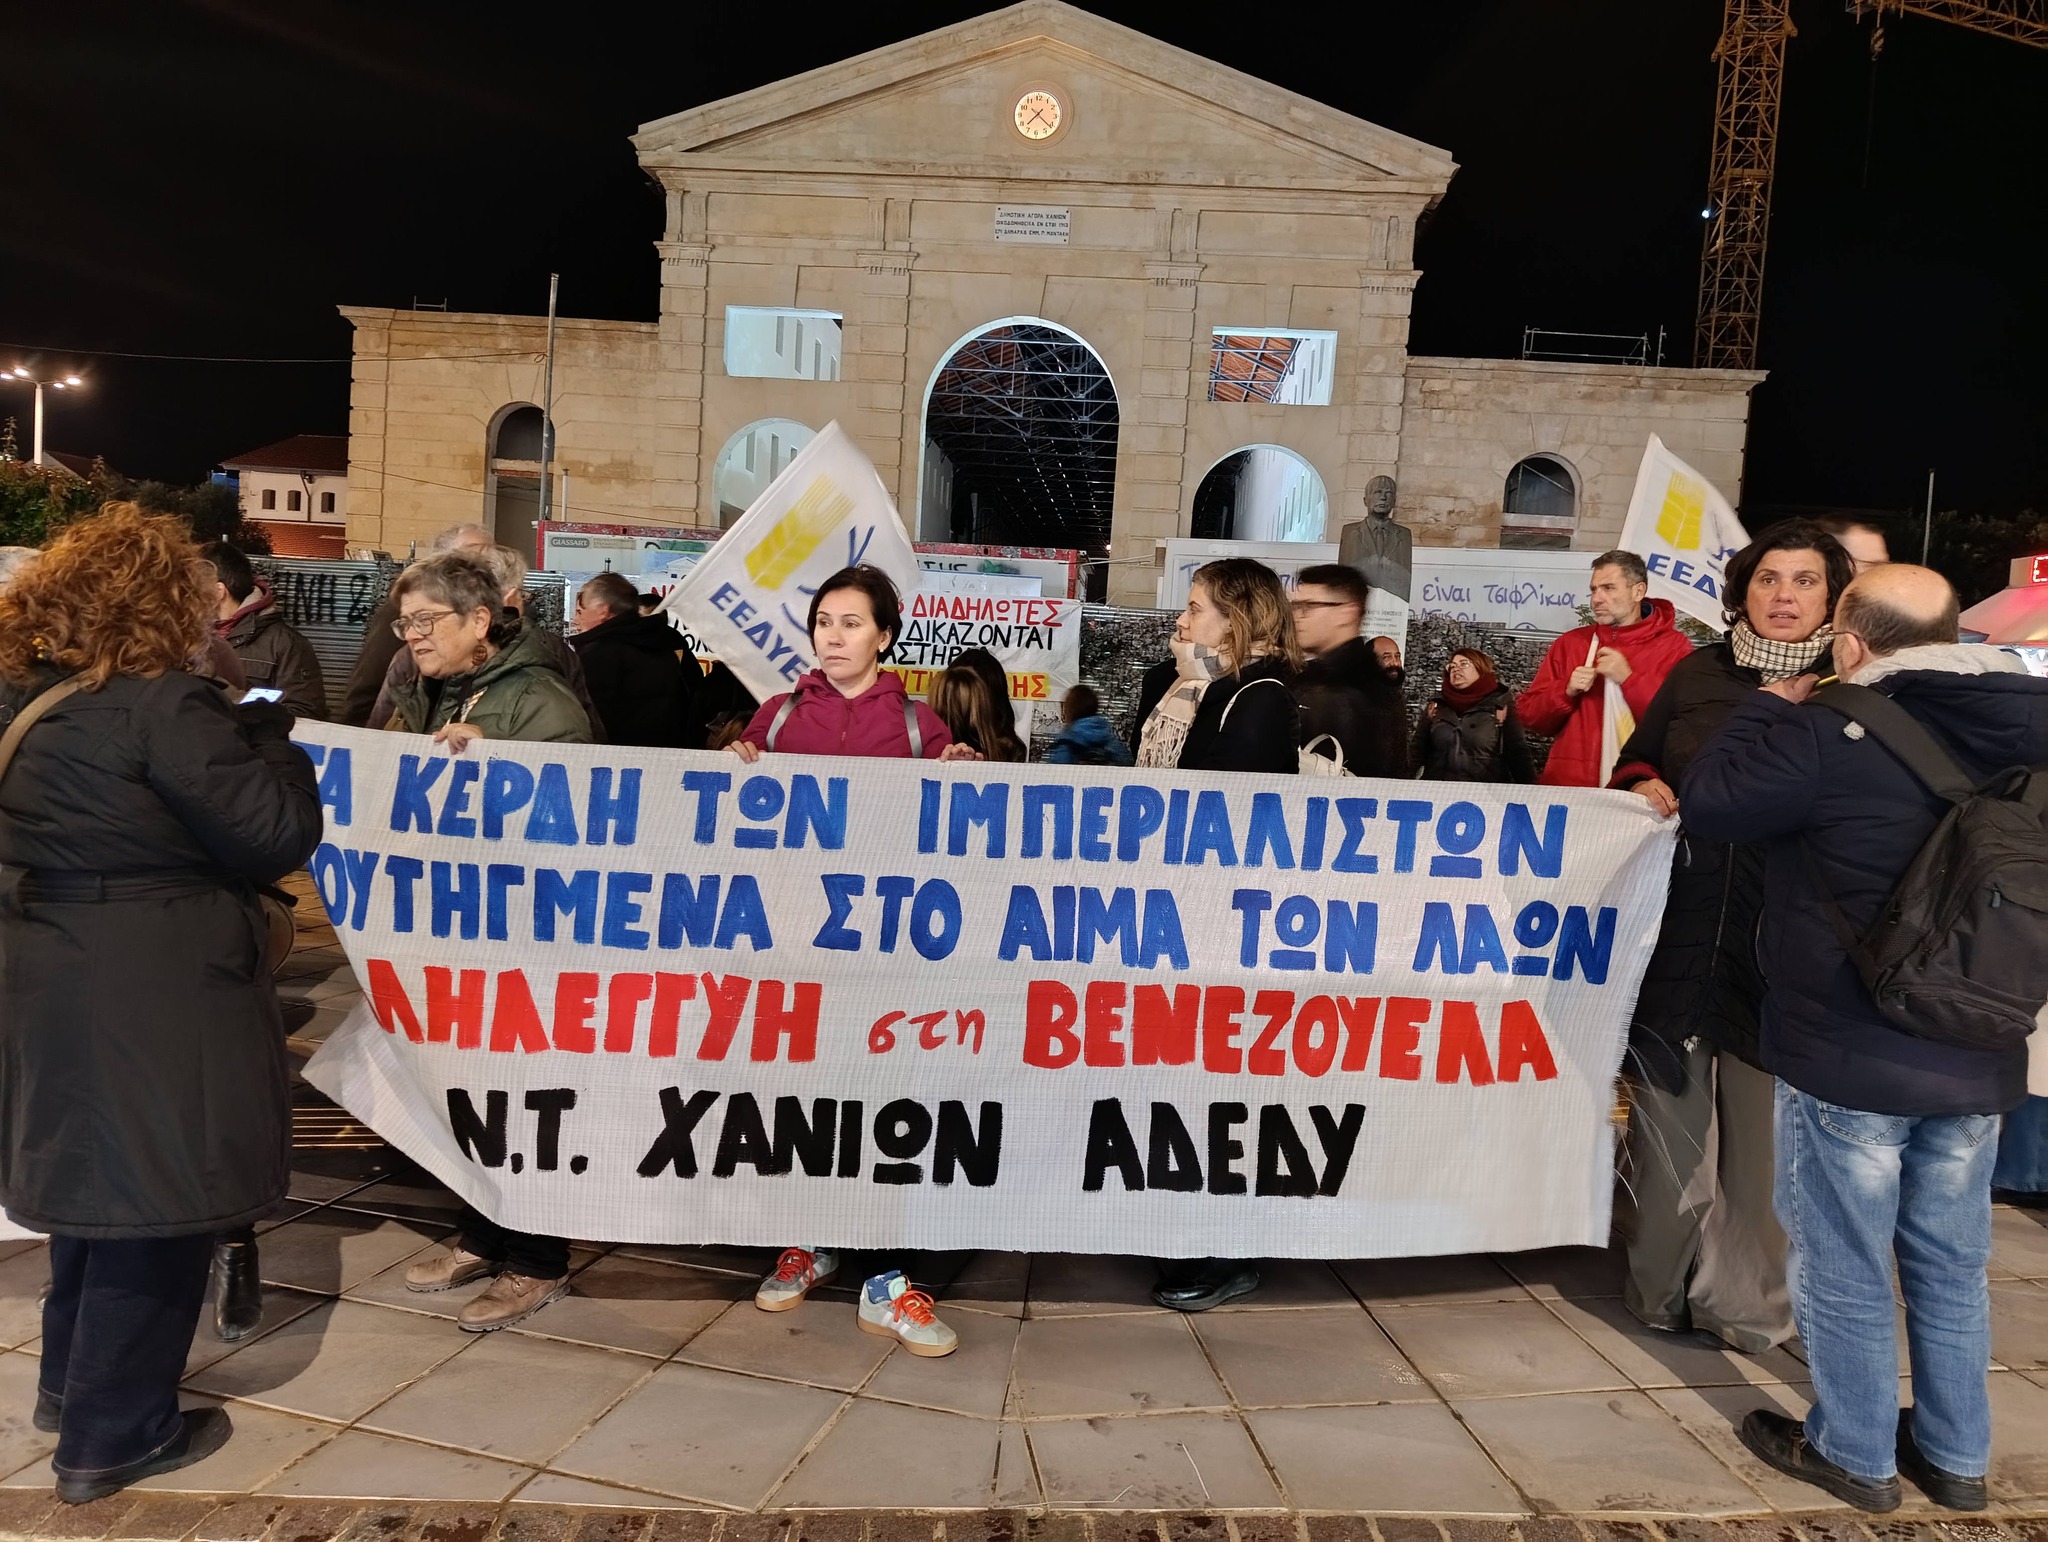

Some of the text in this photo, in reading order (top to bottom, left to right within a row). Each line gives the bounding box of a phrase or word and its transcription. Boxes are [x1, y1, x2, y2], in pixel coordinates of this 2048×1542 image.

[551, 538, 588, 547] GLASSART
[1647, 553, 1725, 600] ΕΕΔ
[708, 582, 810, 683] ΕΕΔΥΕ
[906, 619, 1053, 650] ΔΙΚΑΖΟΝΤΑΙ
[912, 594, 1063, 627] ΔΙΑΔΗΛΩΤΕΣ
[390, 753, 643, 846] ΚΕΡΔΗ
[681, 770, 849, 850] ΤΩΝ
[918, 778, 1568, 879] ΙΜΠΕΡΙΑΛΙΣΤΩΝ
[308, 842, 1618, 985] ΟΥΤΗΓΜΕΝΑ ΣΤΟ ΑΙΜΑ ΤΩΝ ΛΑΩΝ
[362, 958, 1559, 1087] ΛΗΛΕΓΓΥΗ στη ΒΕΝΕΖΟΥΕΛΑ
[636, 1086, 1002, 1187] ΧΑΝΙΩΝ
[1082, 1097, 1366, 1198] ΑΔΕΔΥ
